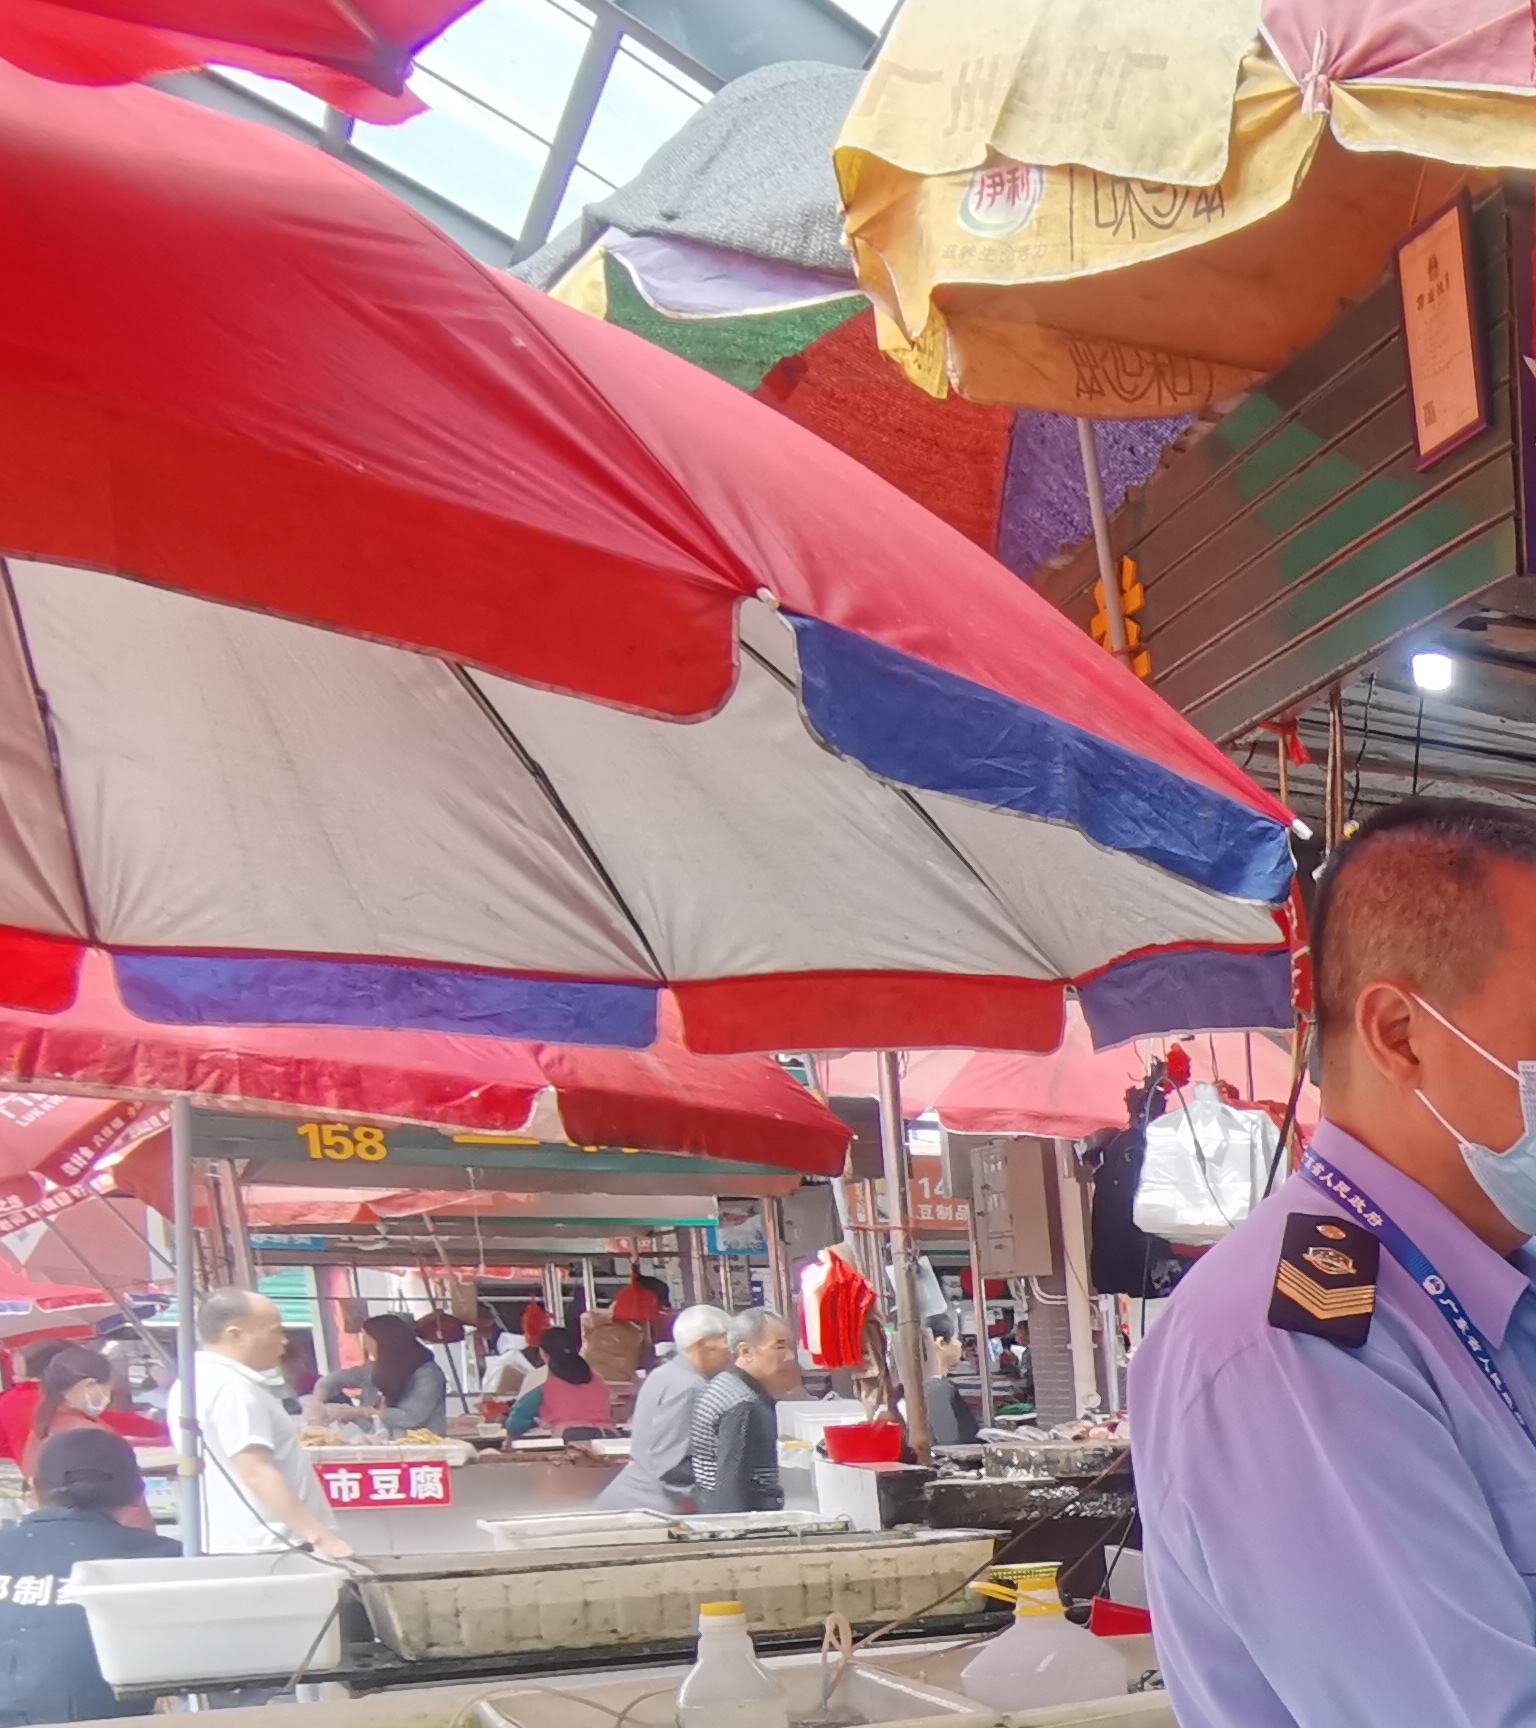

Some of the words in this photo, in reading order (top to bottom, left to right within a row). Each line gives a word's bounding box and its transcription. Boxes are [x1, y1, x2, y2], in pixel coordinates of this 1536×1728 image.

[975, 168, 1031, 212] 伊利
[297, 1122, 388, 1162] 158
[917, 1203, 970, 1221] 豆制品
[322, 1465, 444, 1503] 市豆腐
